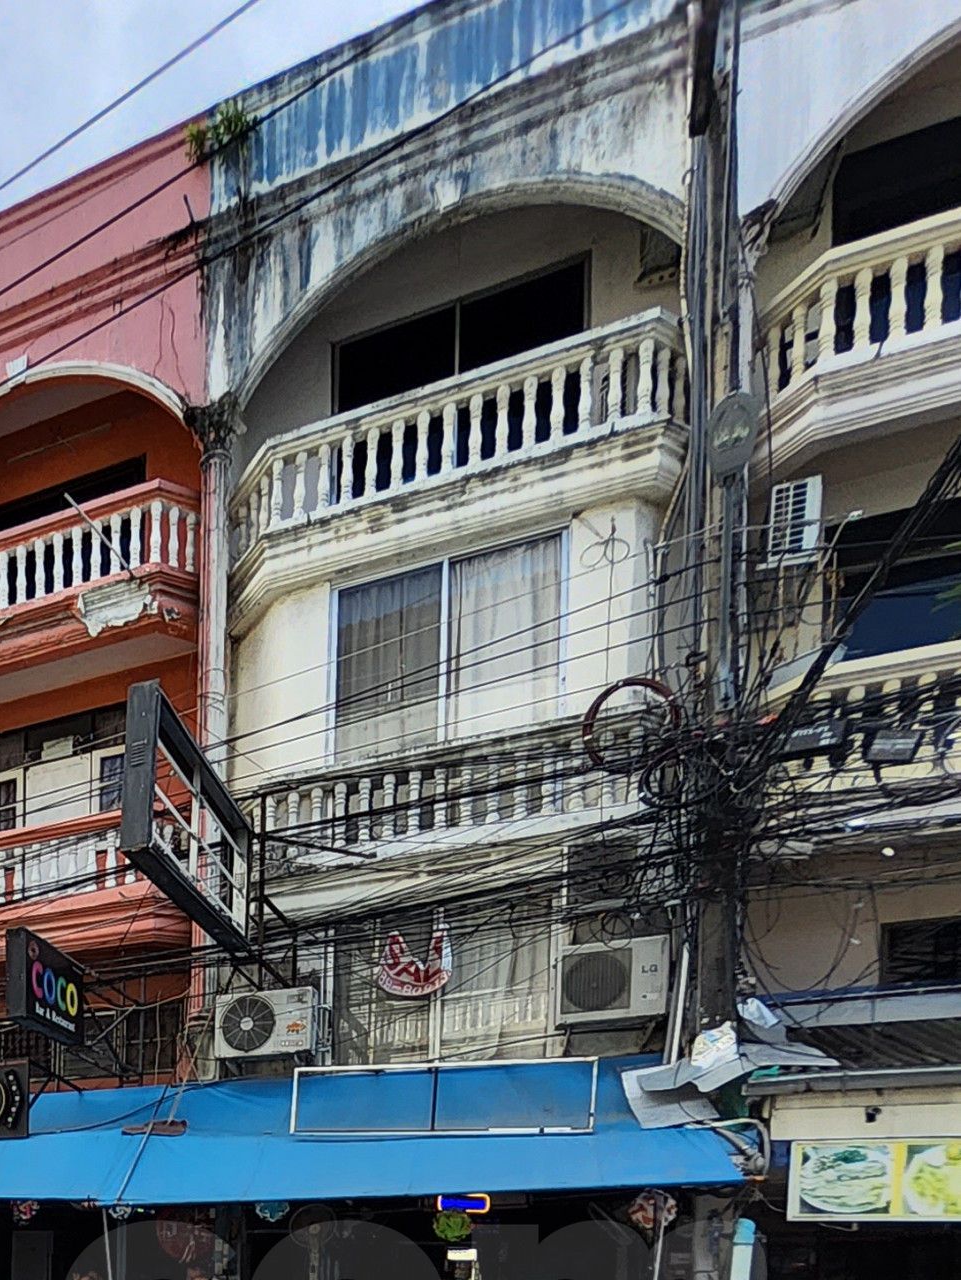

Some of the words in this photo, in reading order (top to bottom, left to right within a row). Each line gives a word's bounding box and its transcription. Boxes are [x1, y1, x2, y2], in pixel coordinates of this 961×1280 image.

[641, 964, 658, 974] LG
[32, 960, 78, 1016] COCO
[35, 1000, 46, 1016] Bar
